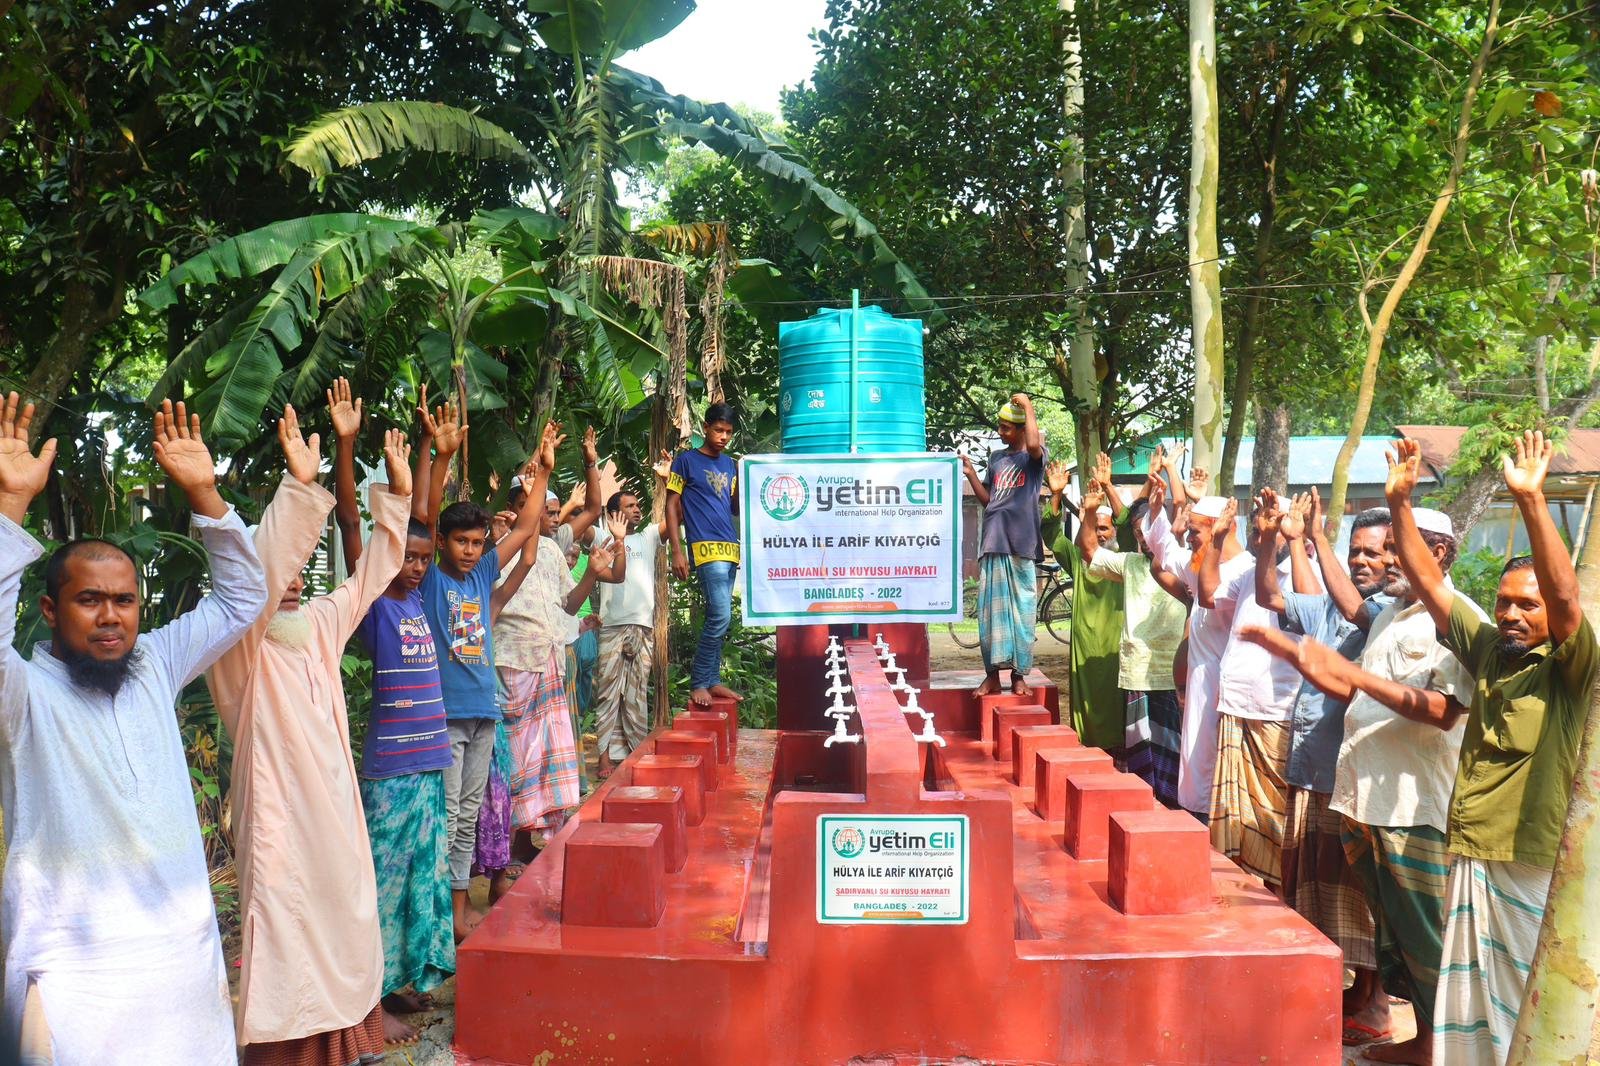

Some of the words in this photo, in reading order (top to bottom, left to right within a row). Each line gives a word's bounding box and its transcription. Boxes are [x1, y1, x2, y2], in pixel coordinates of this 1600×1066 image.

[817, 475, 854, 485] Avrupa
[817, 479, 900, 512] yetim
[905, 478, 943, 504] Eli
[881, 509, 896, 518] Help
[898, 508, 943, 517] Organization
[763, 534, 808, 549] HÜLYA
[812, 534, 834, 548] İLE
[838, 533, 870, 548] ARİF
[875, 532, 941, 550] KIYATÇIĞ
[832, 566, 846, 576] SU
[850, 565, 890, 576] KUYUSU
[894, 565, 937, 576] HAYRATI
[804, 587, 864, 601] BANGLADEŞ
[877, 587, 902, 599] 2022
[870, 828, 895, 836] Avrupa
[869, 832, 926, 853] yetim
[929, 832, 954, 849] Eli
[924, 850, 955, 858] Organization
[833, 866, 865, 878] HÜLYA
[868, 866, 882, 878] İLE
[885, 866, 906, 878] ARİF
[909, 865, 954, 880] KIYATÇIĞ
[835, 887, 877, 896] ŞADIRVANLI
[879, 887, 889, 895] SU
[891, 887, 919, 895] KUYUSU
[921, 887, 950, 895] HAYRATI
[853, 902, 907, 911] BANGLADEŞ
[917, 902, 938, 910] 2022
